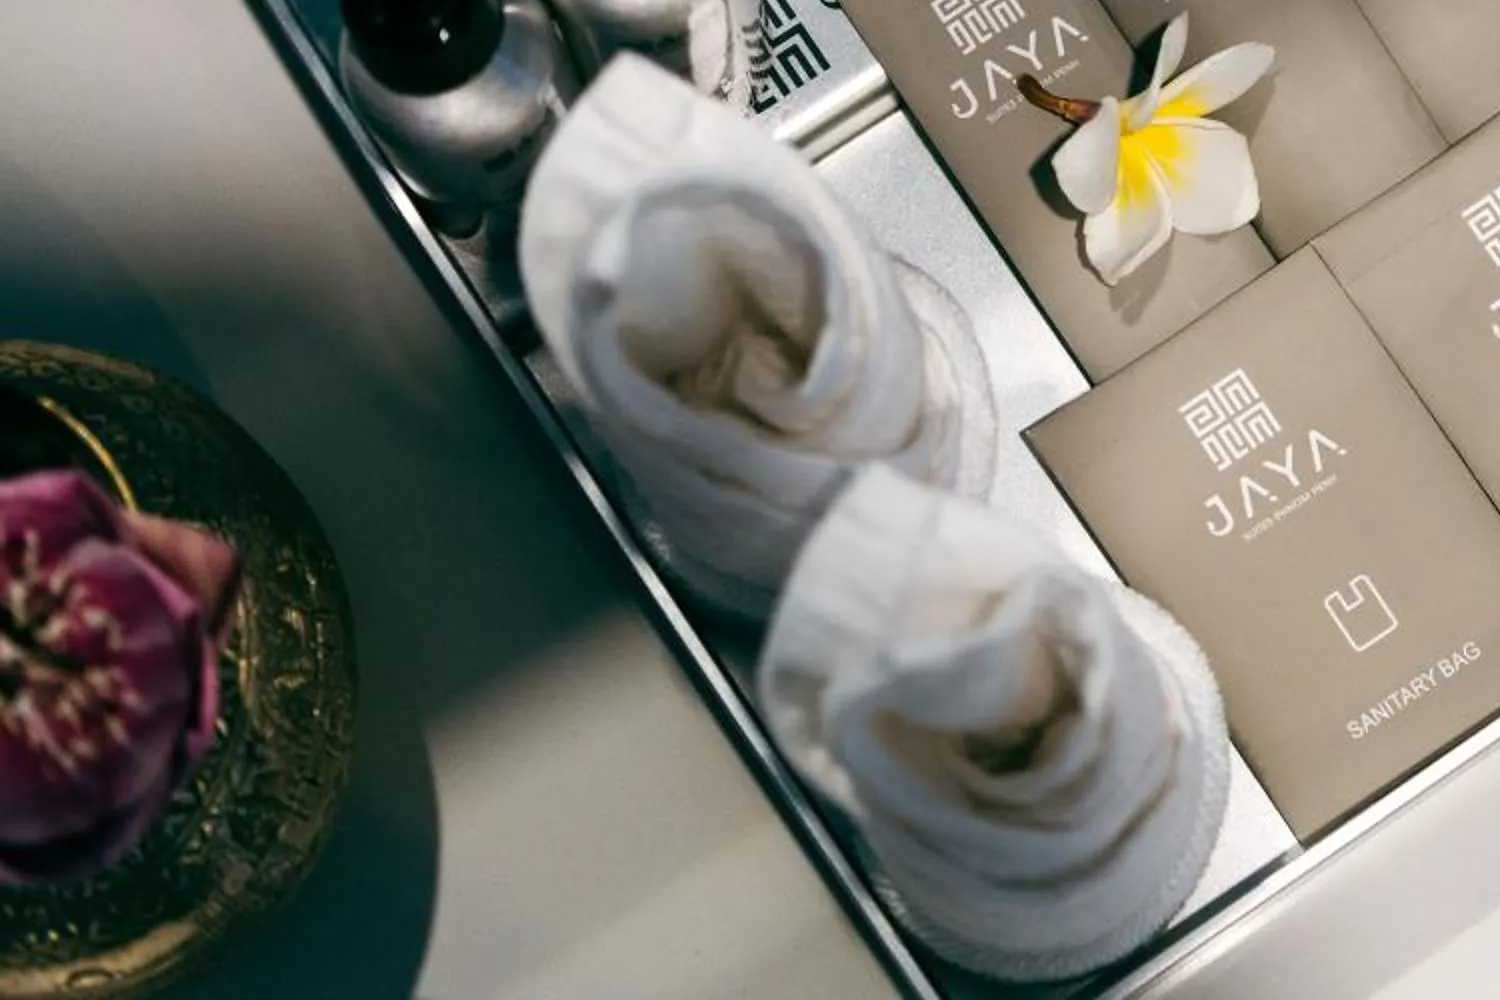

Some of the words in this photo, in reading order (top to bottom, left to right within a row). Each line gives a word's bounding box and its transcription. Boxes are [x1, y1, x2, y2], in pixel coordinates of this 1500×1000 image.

[949, 16, 1090, 119] JAYA
[1204, 429, 1348, 537] JAYA
[1346, 666, 1438, 739] SANITARY
[1437, 640, 1482, 678] BAG
